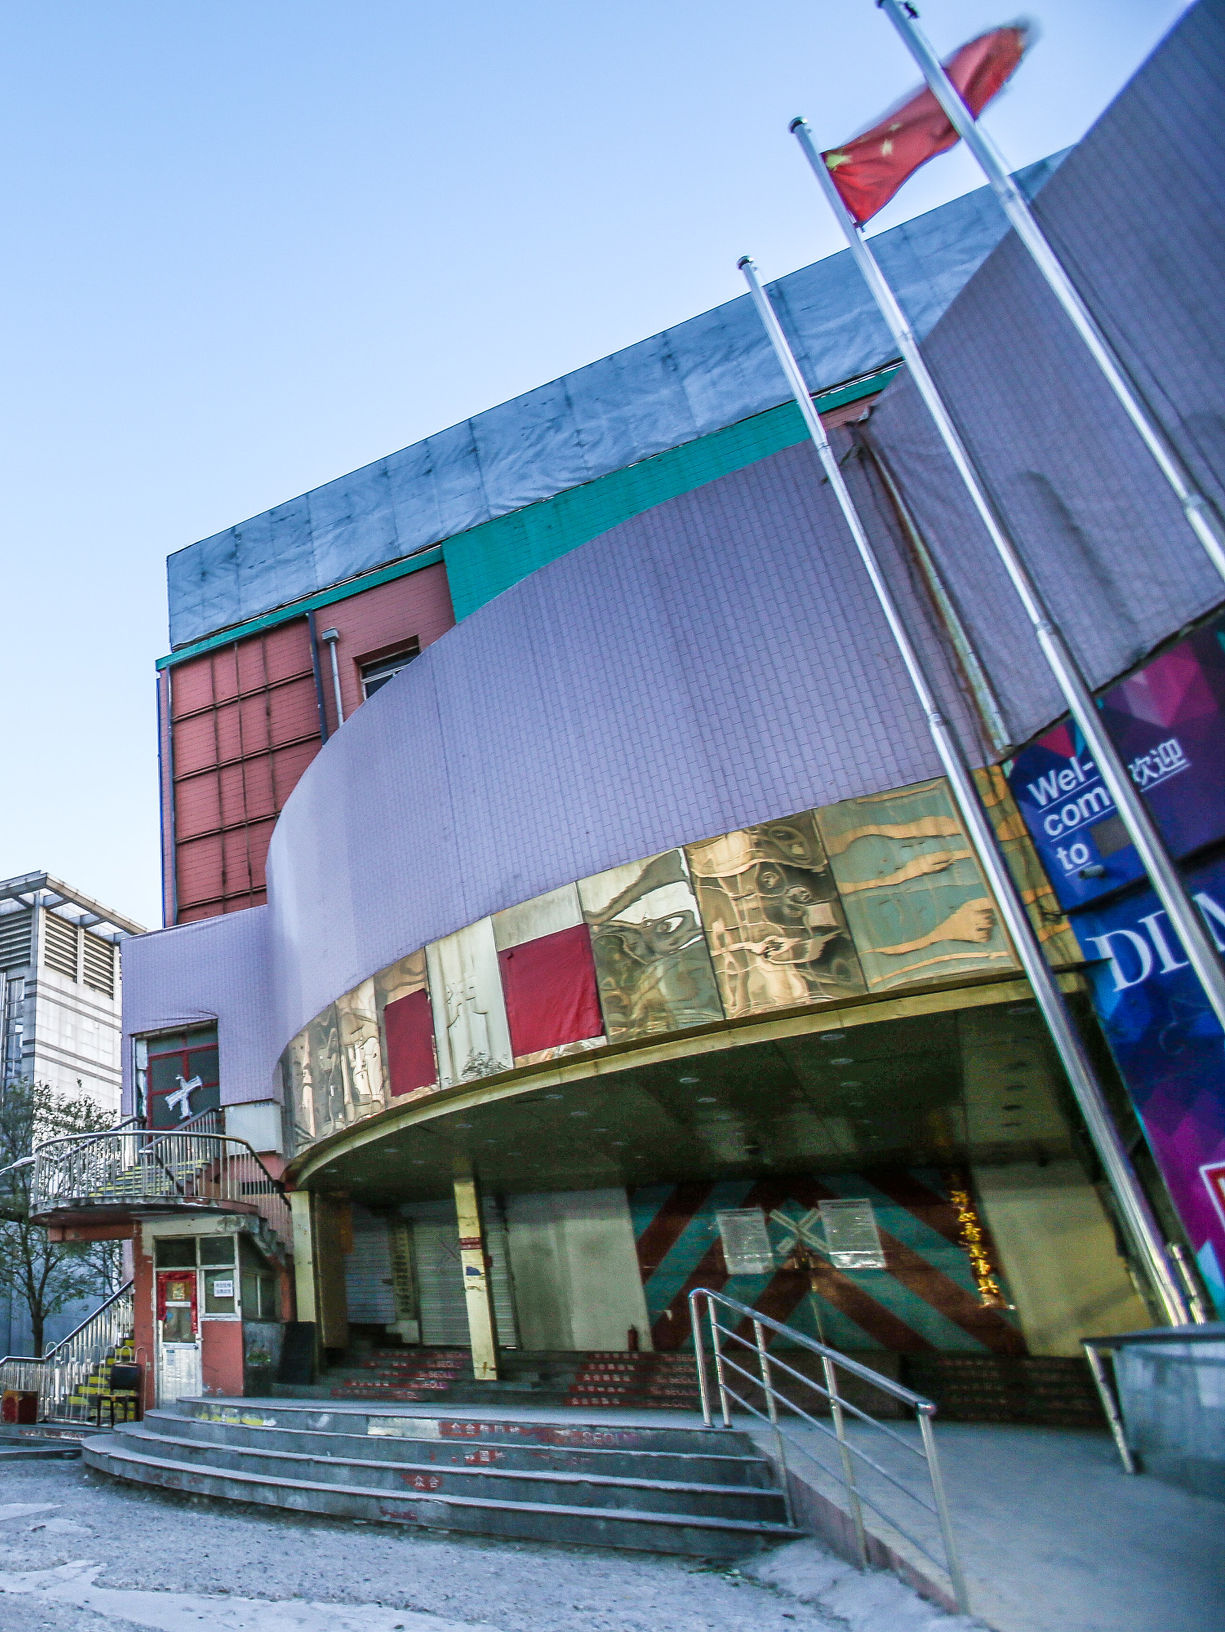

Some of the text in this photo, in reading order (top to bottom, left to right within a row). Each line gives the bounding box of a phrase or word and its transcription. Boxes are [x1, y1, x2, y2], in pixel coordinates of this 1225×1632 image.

[1027, 756, 1094, 806] Wel-
[1043, 786, 1111, 836] com
[1056, 843, 1089, 870] to
